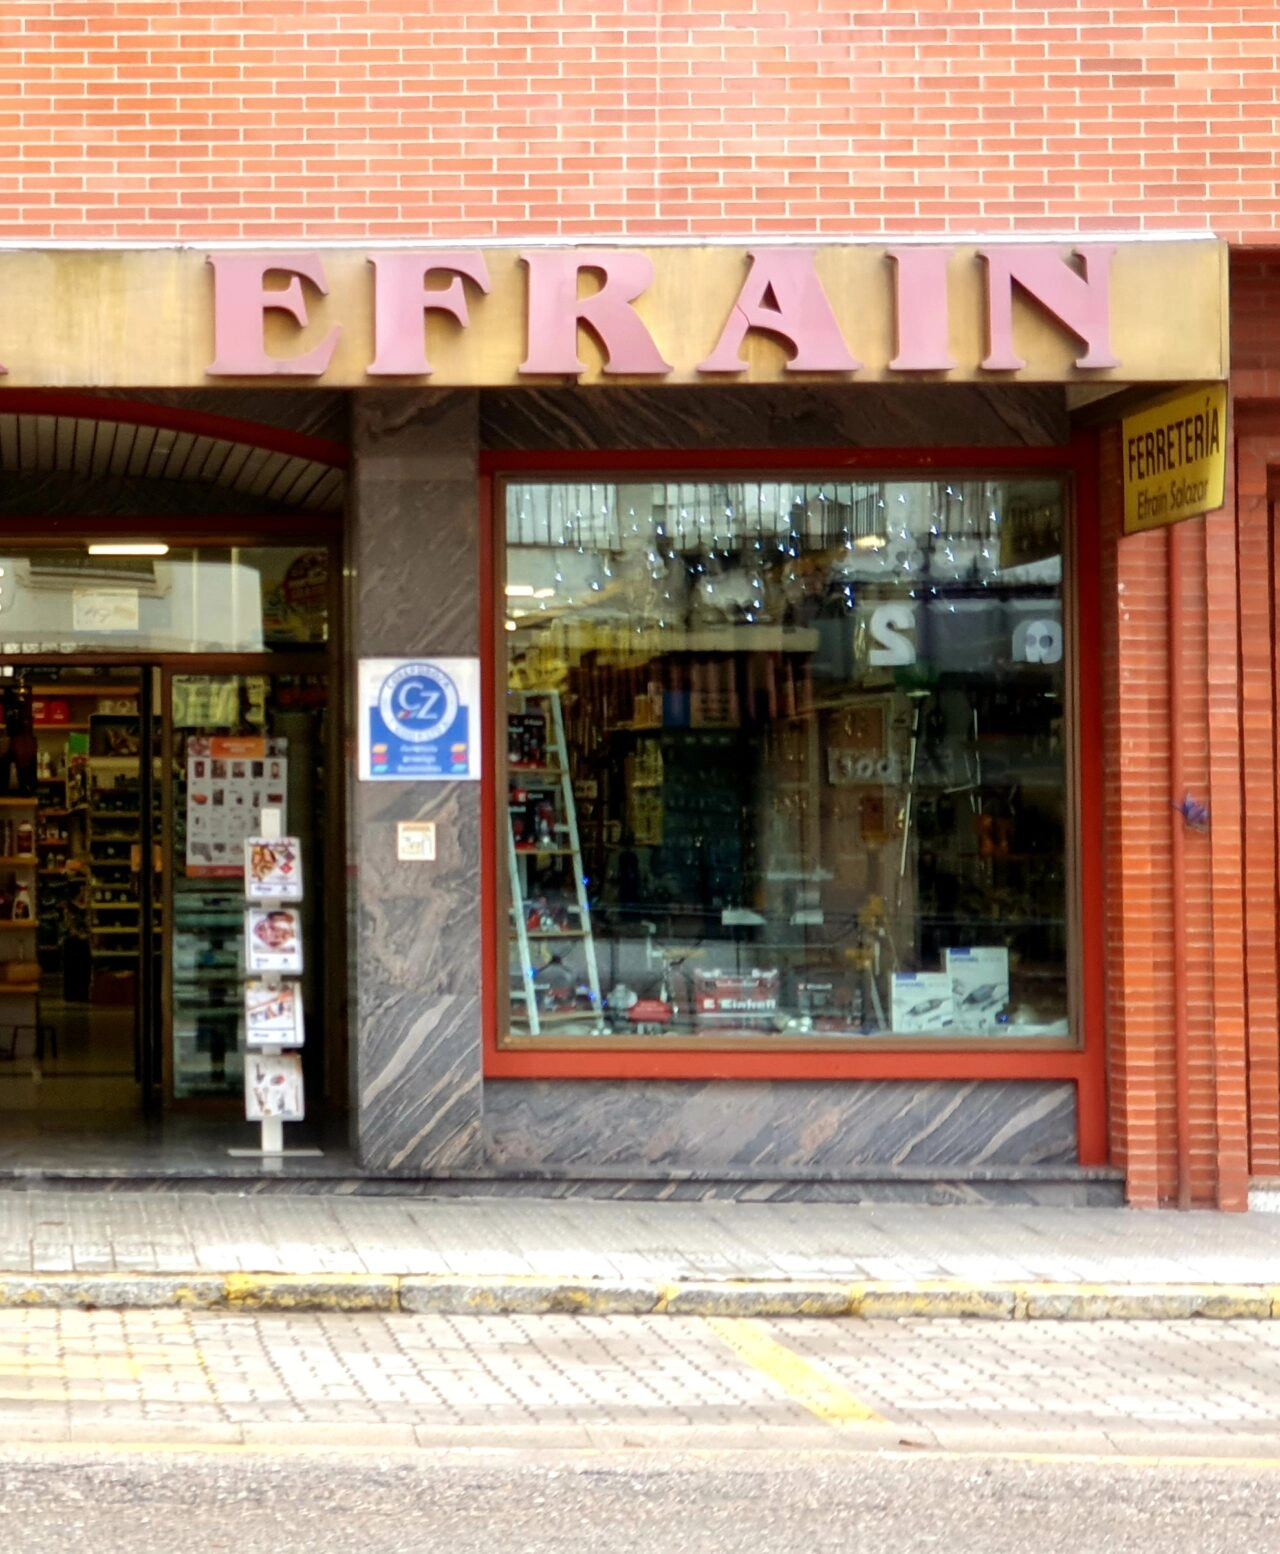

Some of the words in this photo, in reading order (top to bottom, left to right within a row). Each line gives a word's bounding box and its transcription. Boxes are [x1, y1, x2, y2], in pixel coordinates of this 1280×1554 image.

[205, 247, 1122, 375] EFRAIN
[1127, 397, 1220, 483] FERRETERÍA
[1170, 478, 1209, 511] Salazar
[398, 681, 441, 720] CZ
